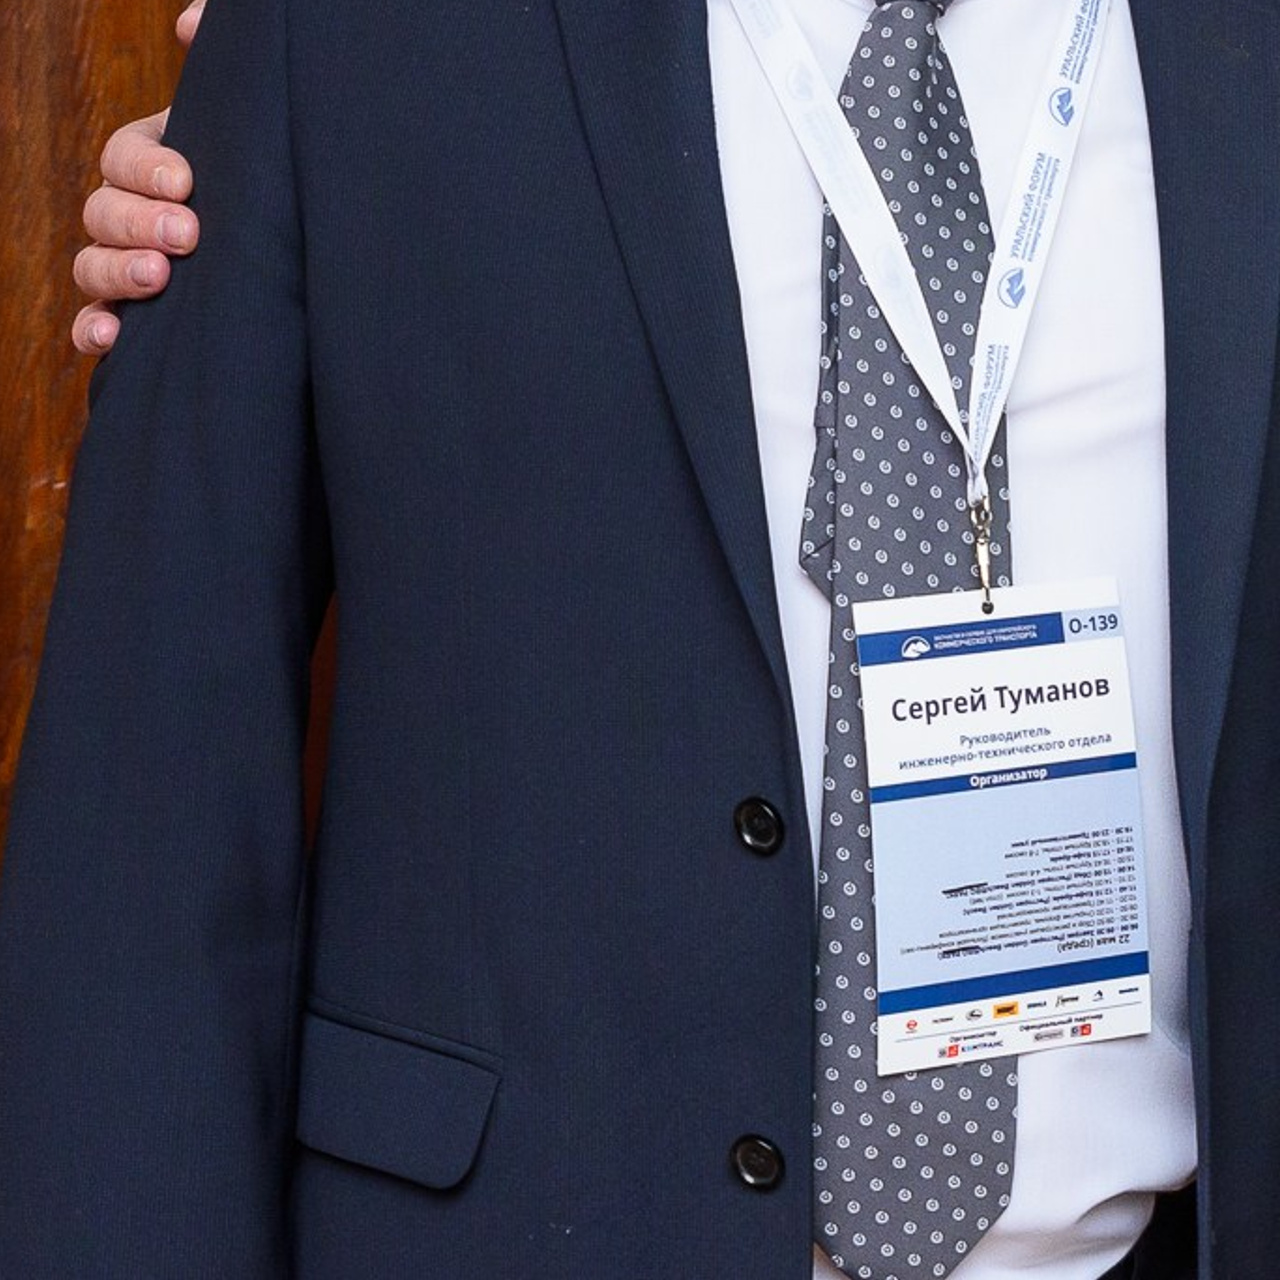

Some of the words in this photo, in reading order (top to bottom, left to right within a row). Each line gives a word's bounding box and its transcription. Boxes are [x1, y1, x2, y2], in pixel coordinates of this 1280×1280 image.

[1058, 14, 1086, 78] УРАЛЬСКИЙ
[1009, 192, 1035, 259] УРАЛЬСКИЙ
[1028, 152, 1046, 192] ФОРУМ
[1068, 613, 1118, 634] О-139
[891, 686, 987, 724] Сергей
[993, 677, 1110, 714] Туманов
[959, 726, 1051, 747] Руководитель
[899, 740, 1065, 770] инженерно-технического
[1068, 732, 1112, 749] отдела
[970, 767, 1047, 789] Организатор
[1057, 939, 1094, 953] (среда)
[1118, 933, 1130, 944] 22
